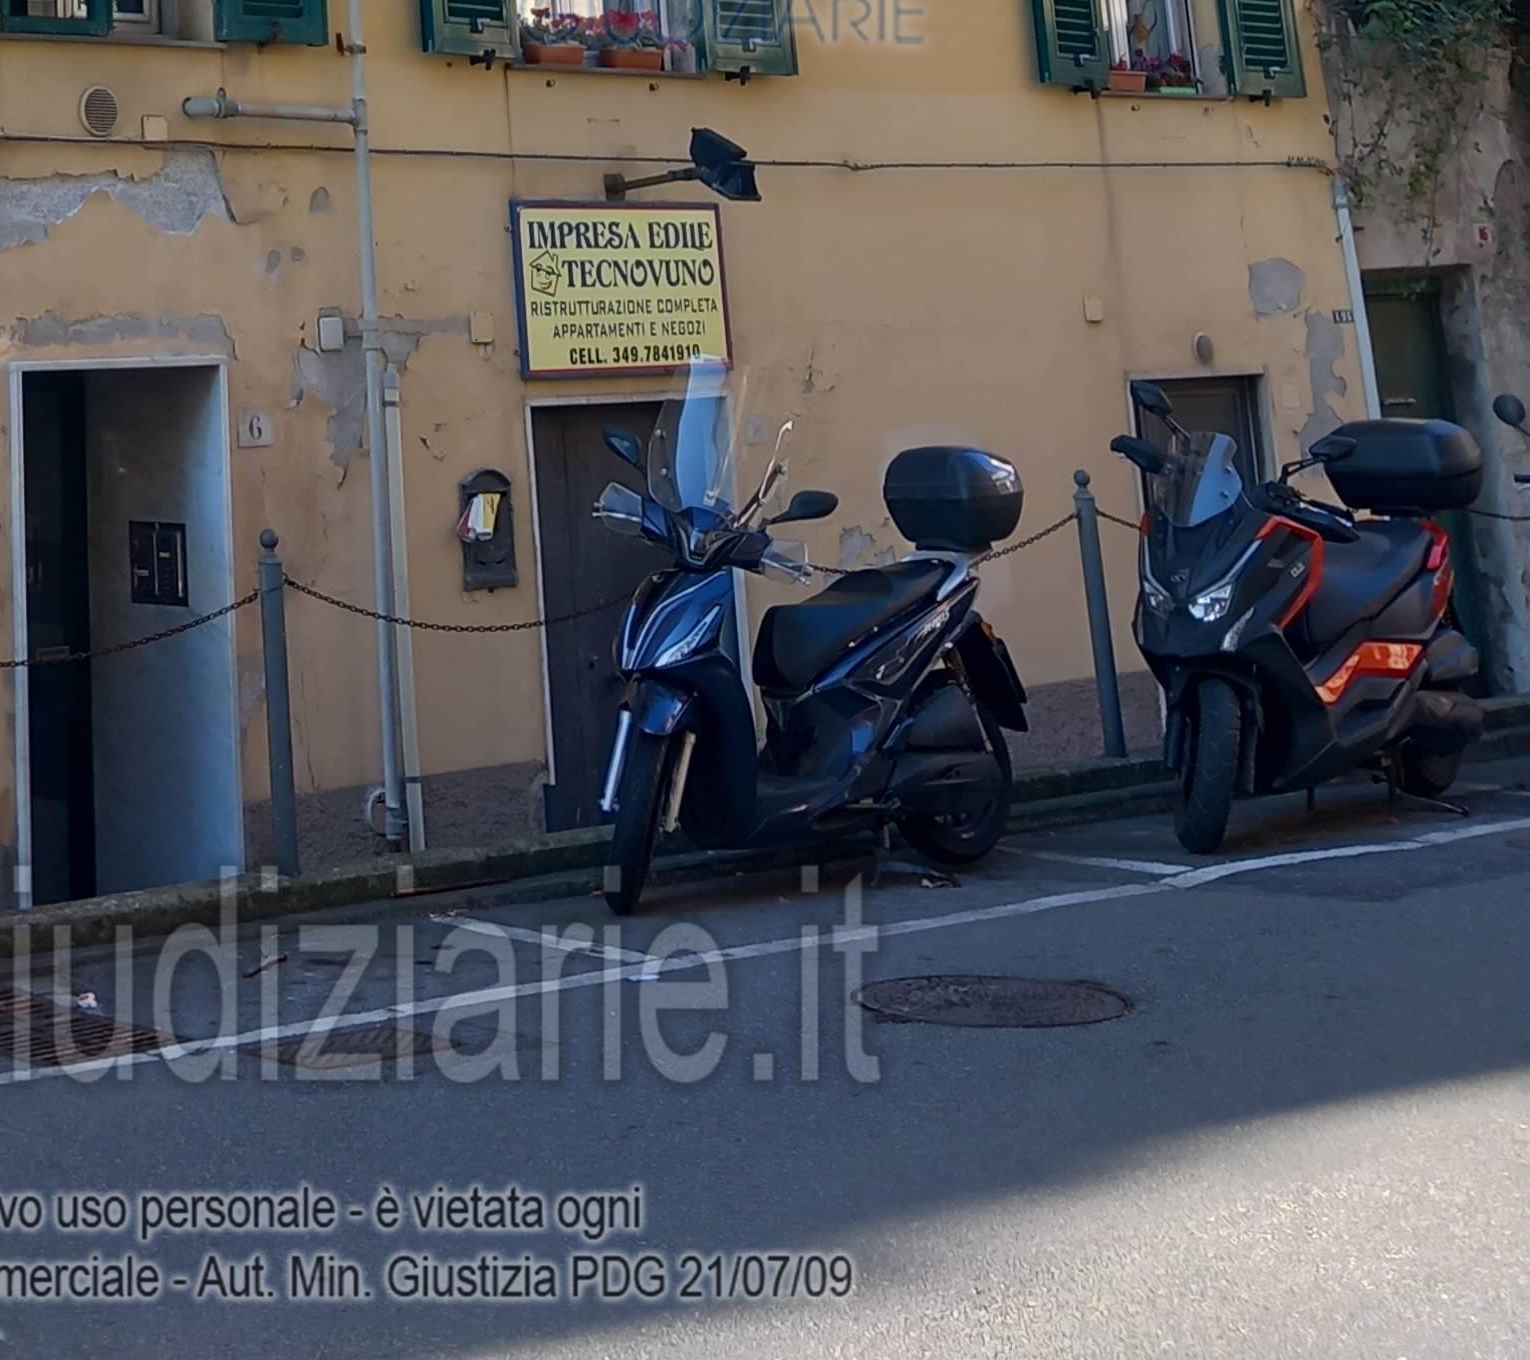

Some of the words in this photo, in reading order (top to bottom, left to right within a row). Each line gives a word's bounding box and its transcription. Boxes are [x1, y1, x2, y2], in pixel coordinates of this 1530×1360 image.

[526, 220, 641, 250] IMPRESA
[648, 221, 714, 251] EDILE
[561, 258, 715, 288] TECNOVUNO
[530, 298, 652, 317] RISTRUTTURAZIONE
[656, 297, 719, 313] COMPLETA
[552, 322, 645, 340] APPARTAMENTI
[650, 321, 657, 336] E
[661, 320, 706, 336] NEGOZI
[569, 347, 608, 365] CELL.
[612, 343, 701, 364] 349.7841910
[249, 415, 263, 441] 6
